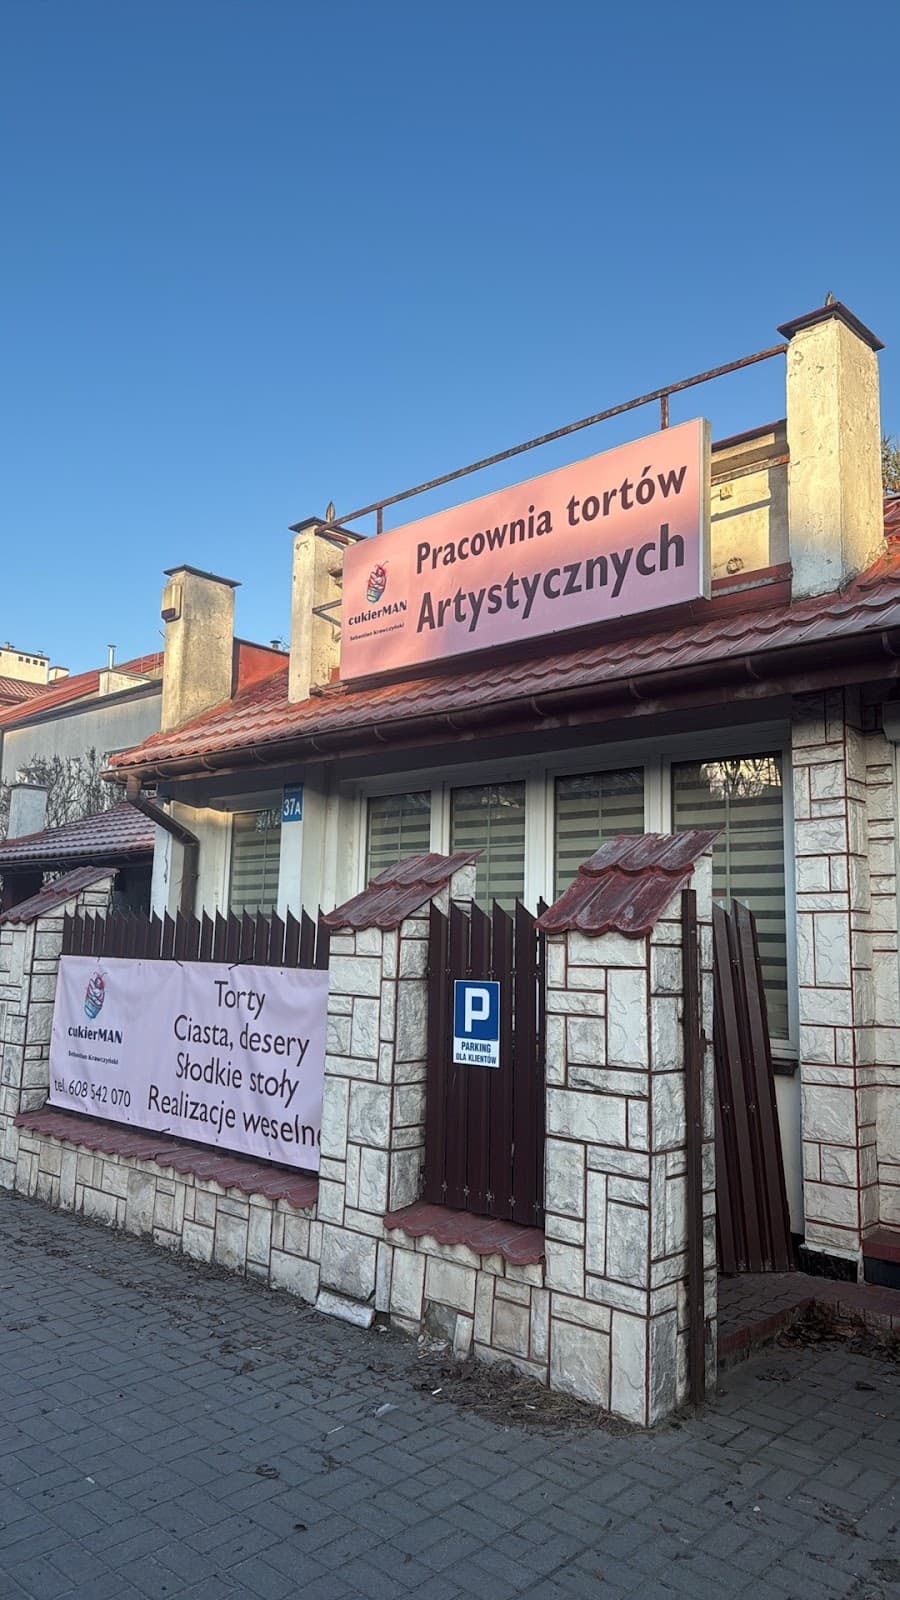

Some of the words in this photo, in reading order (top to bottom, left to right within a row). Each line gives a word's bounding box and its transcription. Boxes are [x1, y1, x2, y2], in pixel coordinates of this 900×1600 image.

[416, 505, 553, 574] Pracownia
[566, 465, 687, 526] tortów
[416, 523, 685, 633] Artystycznych
[348, 600, 407, 625] cukierMAN
[283, 798, 301, 816] 37A
[214, 980, 266, 1020] Torty
[464, 987, 490, 1033] P
[68, 1025, 123, 1044] cukierMAN
[174, 1014, 234, 1051] Ciasta,
[239, 1023, 310, 1067] desery
[461, 1041, 491, 1053] PARKING
[455, 1052, 467, 1061] DLA
[468, 1053, 497, 1065] KLIENTÓW
[54, 1078, 68, 1094] tel.
[68, 1079, 88, 1098] 608
[91, 1083, 108, 1103] 542
[111, 1088, 131, 1107] 070
[176, 1051, 243, 1089] Słodkie
[250, 1069, 300, 1108] stoły
[148, 1084, 236, 1134] Realizacje
